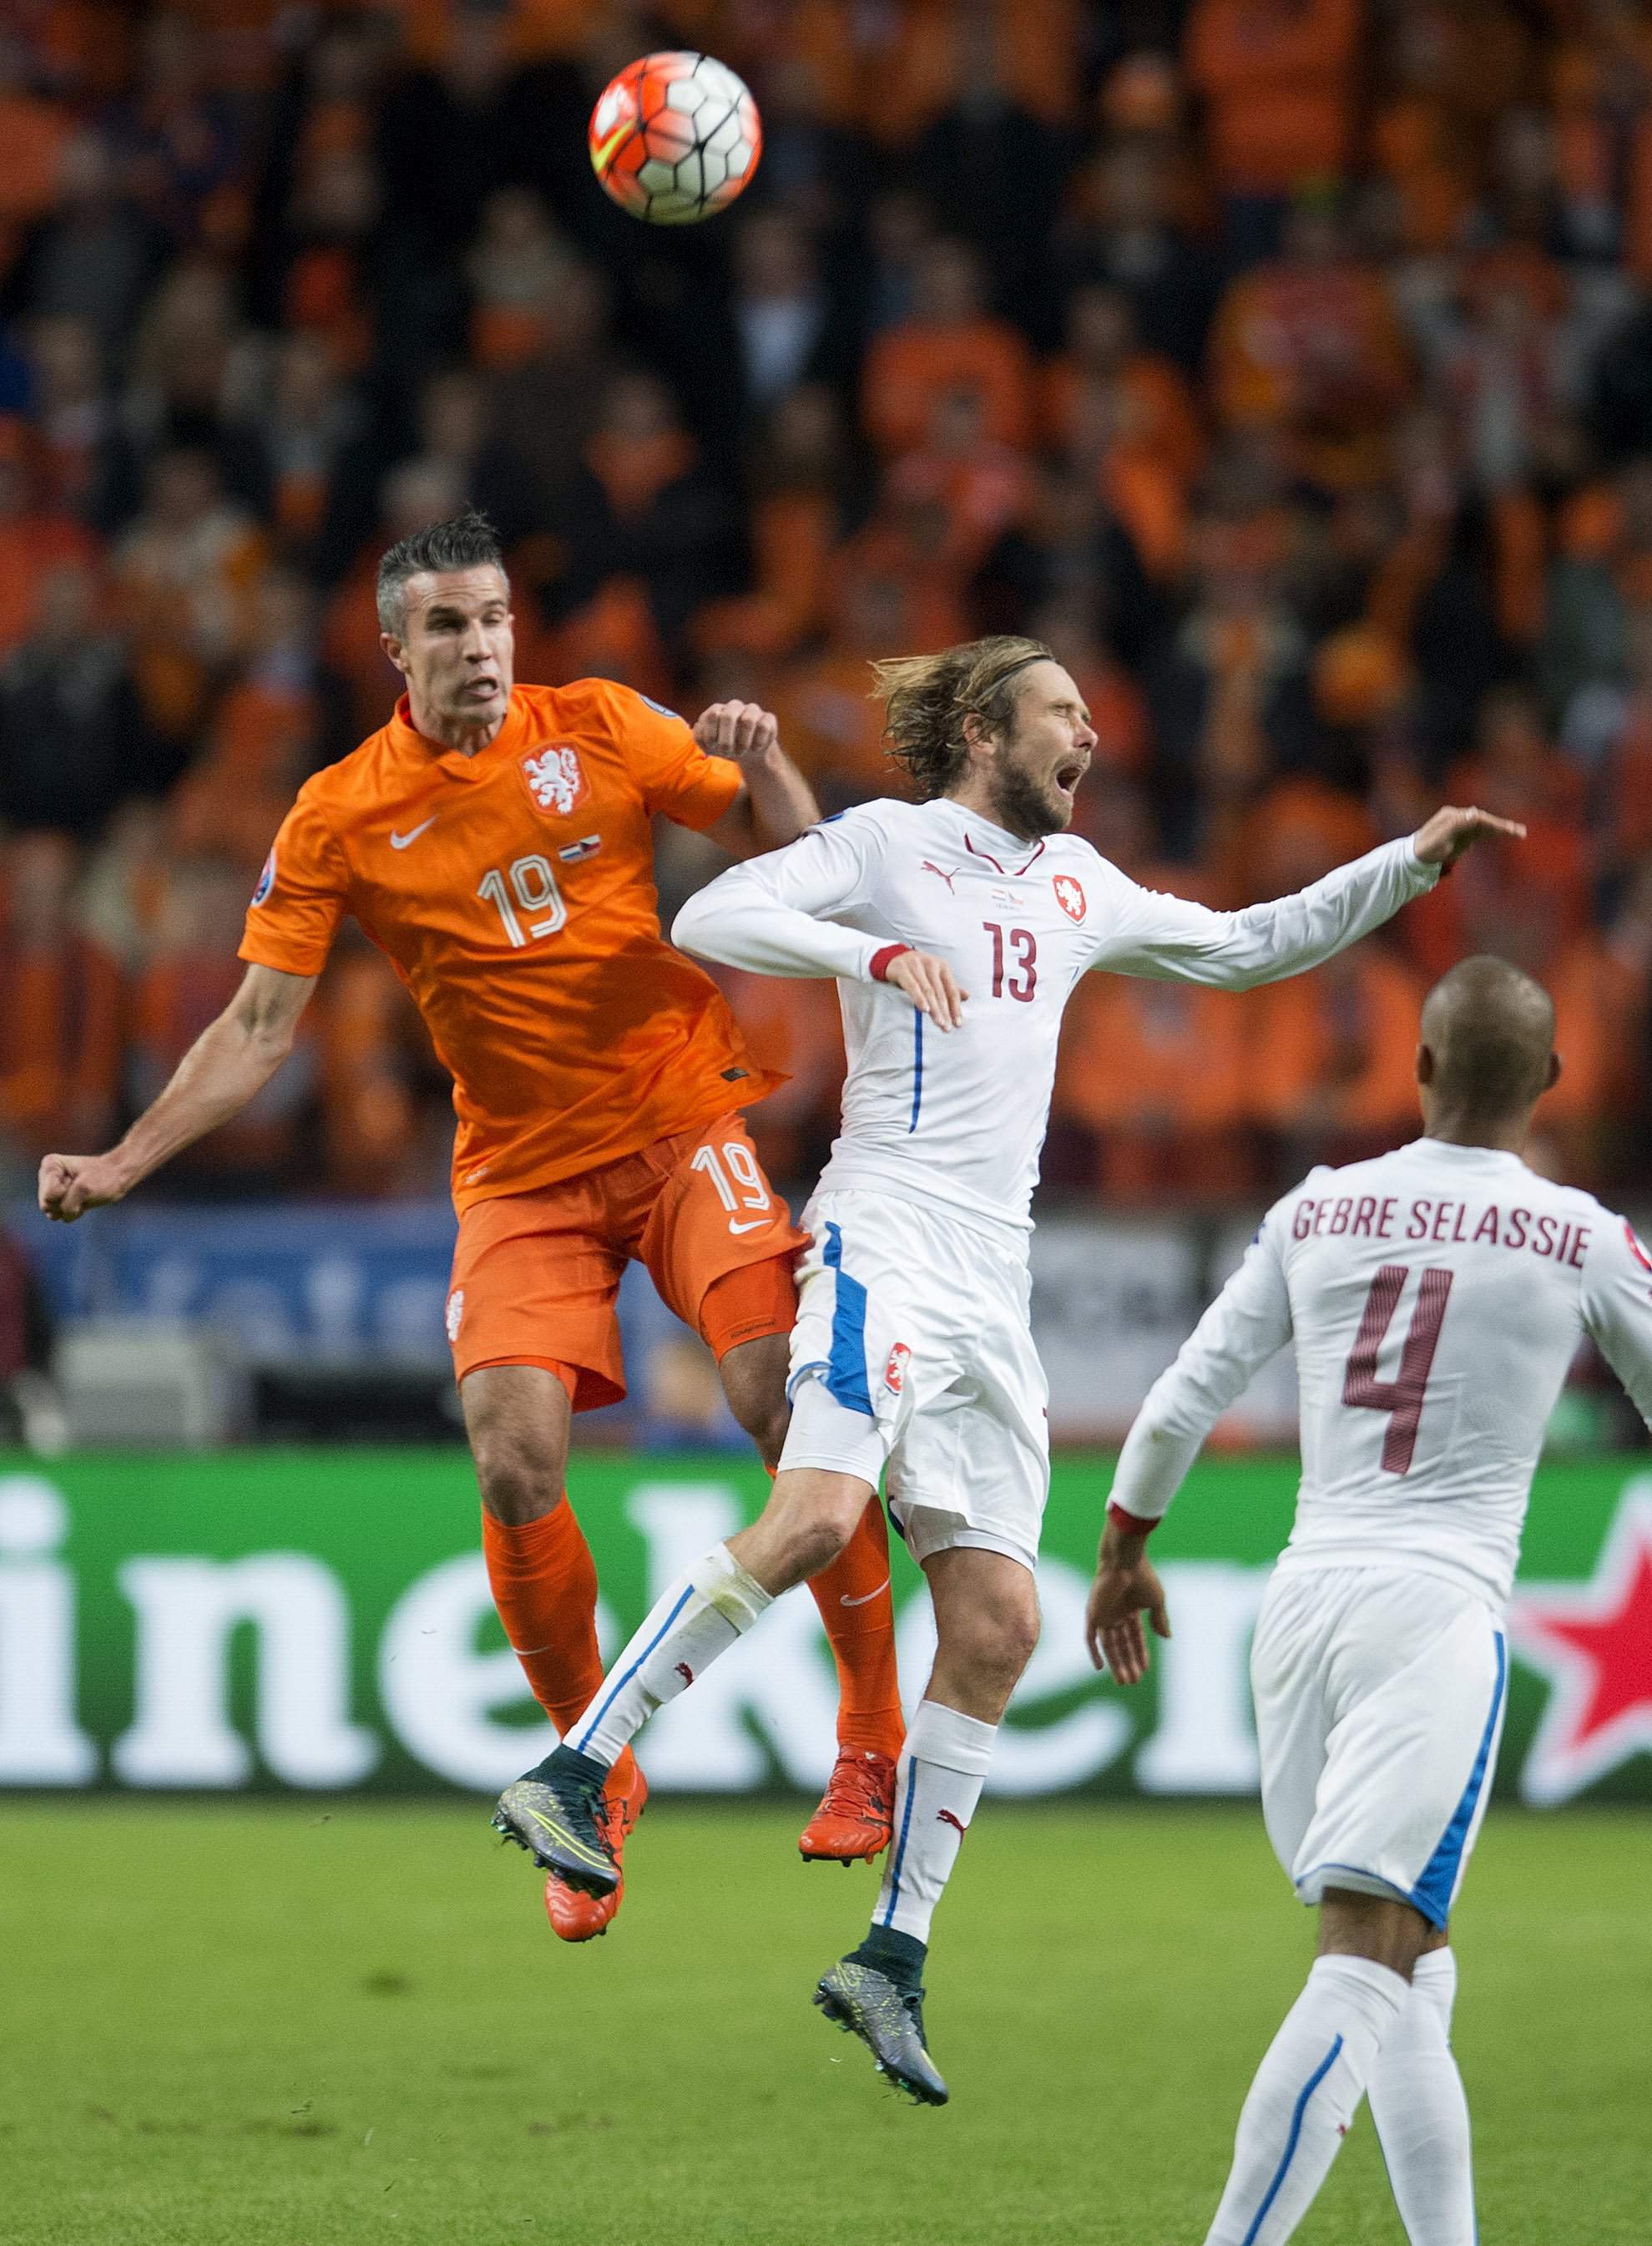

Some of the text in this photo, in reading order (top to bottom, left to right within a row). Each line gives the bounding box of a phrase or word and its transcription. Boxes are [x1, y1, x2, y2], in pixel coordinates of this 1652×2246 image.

[477, 854, 568, 948] 19
[983, 921, 1038, 1003] 13
[690, 1141, 770, 1212] 19
[1292, 1195, 1593, 1270] GEBRE SELASSIE
[1343, 1265, 1453, 1475] 4
